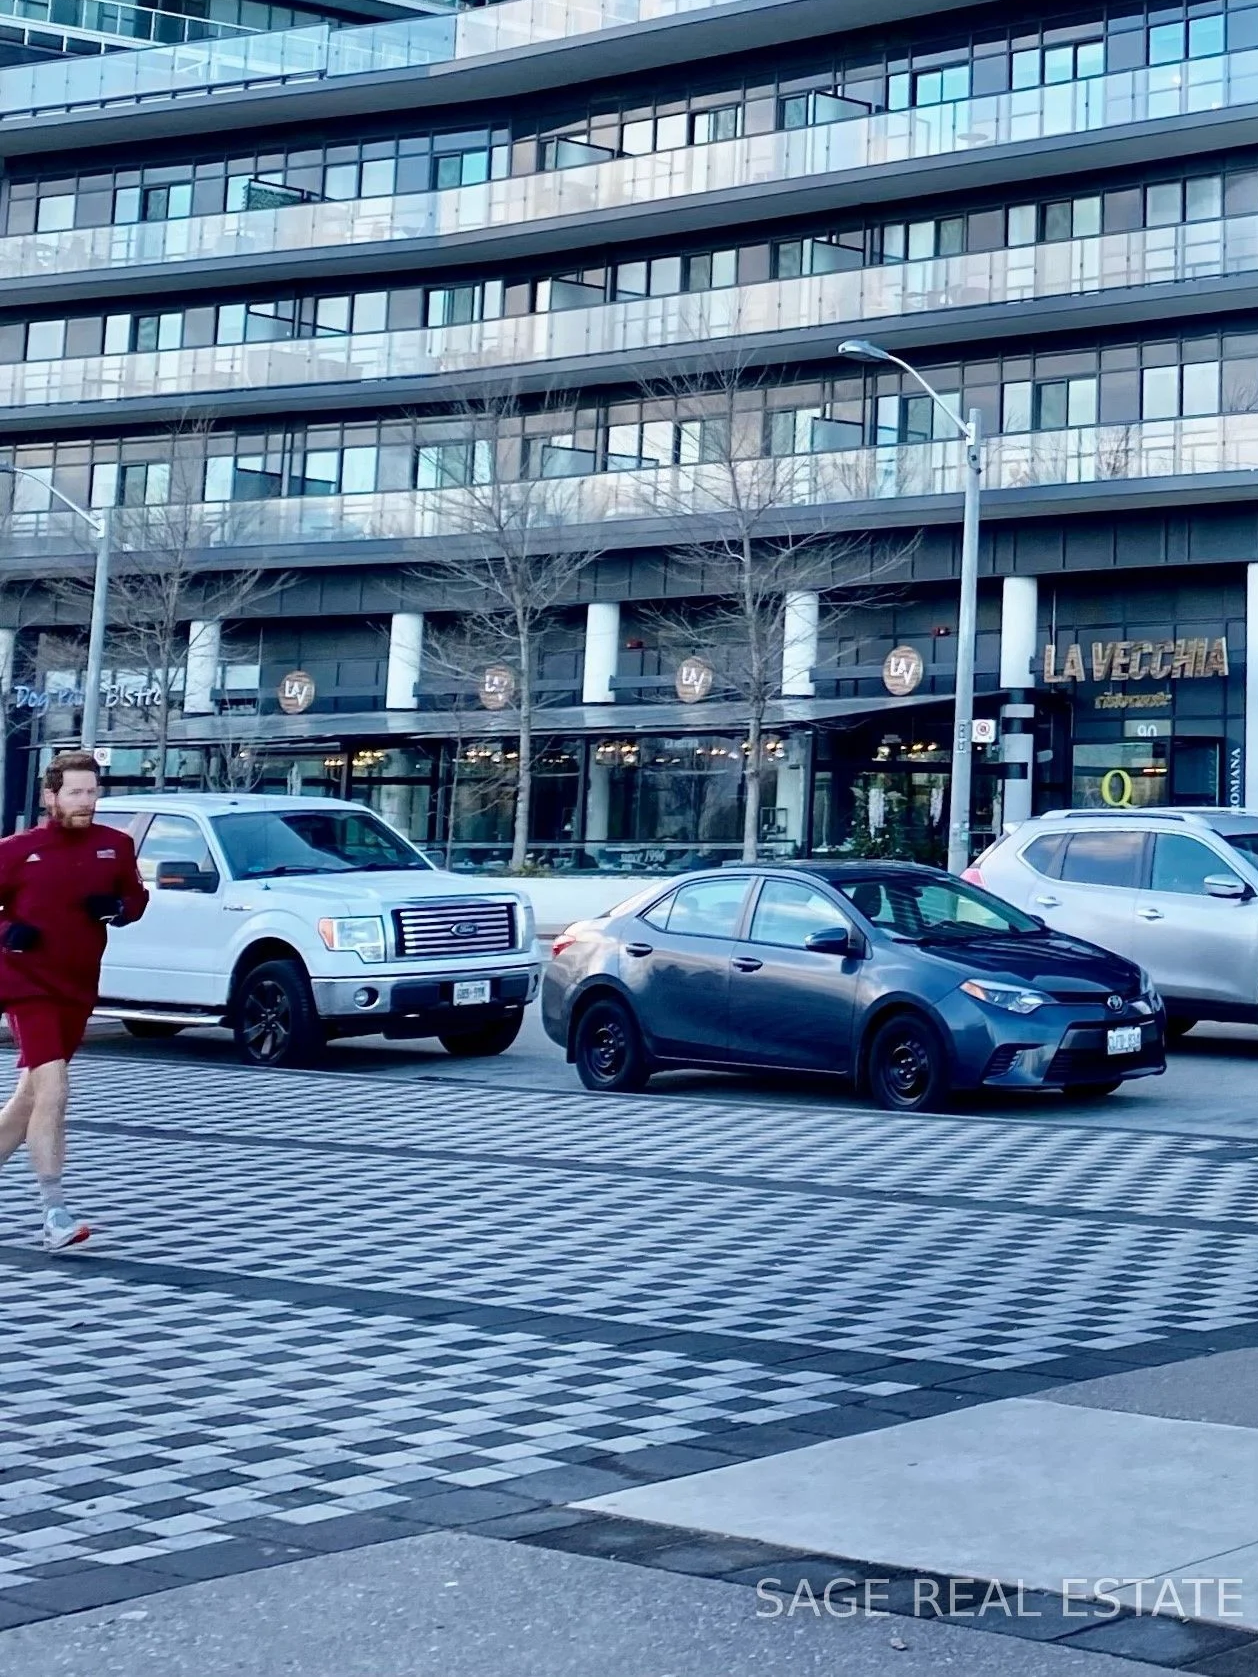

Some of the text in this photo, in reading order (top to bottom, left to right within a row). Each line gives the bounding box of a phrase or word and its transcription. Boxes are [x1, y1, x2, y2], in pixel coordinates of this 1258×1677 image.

[890, 657, 916, 685] LAV
[1043, 636, 1229, 683] LA VECCHIA
[285, 679, 308, 706] LAV
[681, 666, 704, 694] LAV
[14, 685, 49, 718] Dog
[1101, 769, 1135, 808] Q
